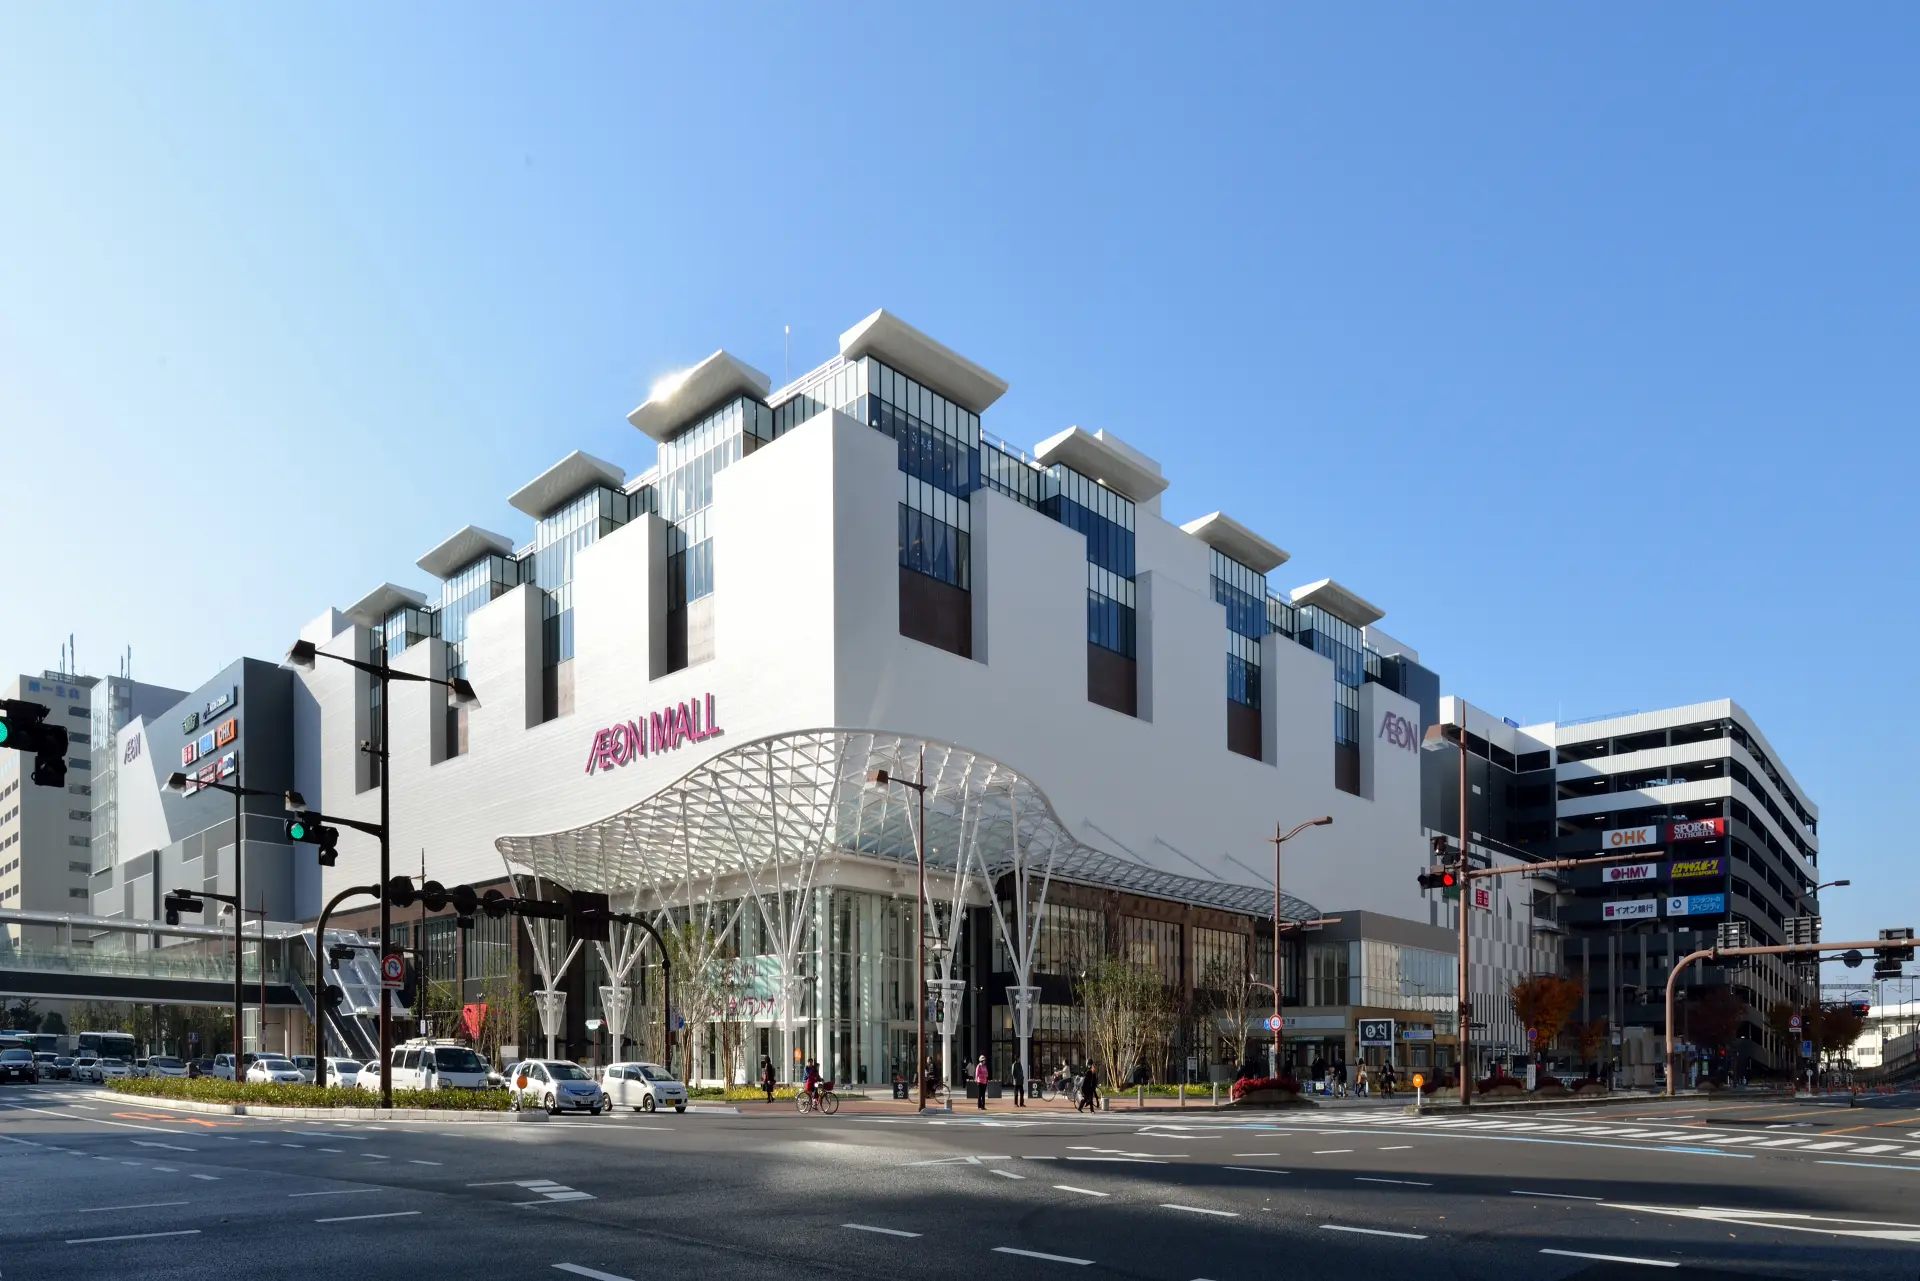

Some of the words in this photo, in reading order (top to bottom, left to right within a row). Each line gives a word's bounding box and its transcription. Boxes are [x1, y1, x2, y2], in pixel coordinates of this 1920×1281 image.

[650, 692, 720, 752] MALL
[1674, 820, 1715, 835] SPORTS
[1611, 829, 1647, 846] OHK
[1621, 866, 1649, 879] HMV
[1615, 904, 1654, 915] イオン銀行
[1272, 1019, 1280, 1028] 40
